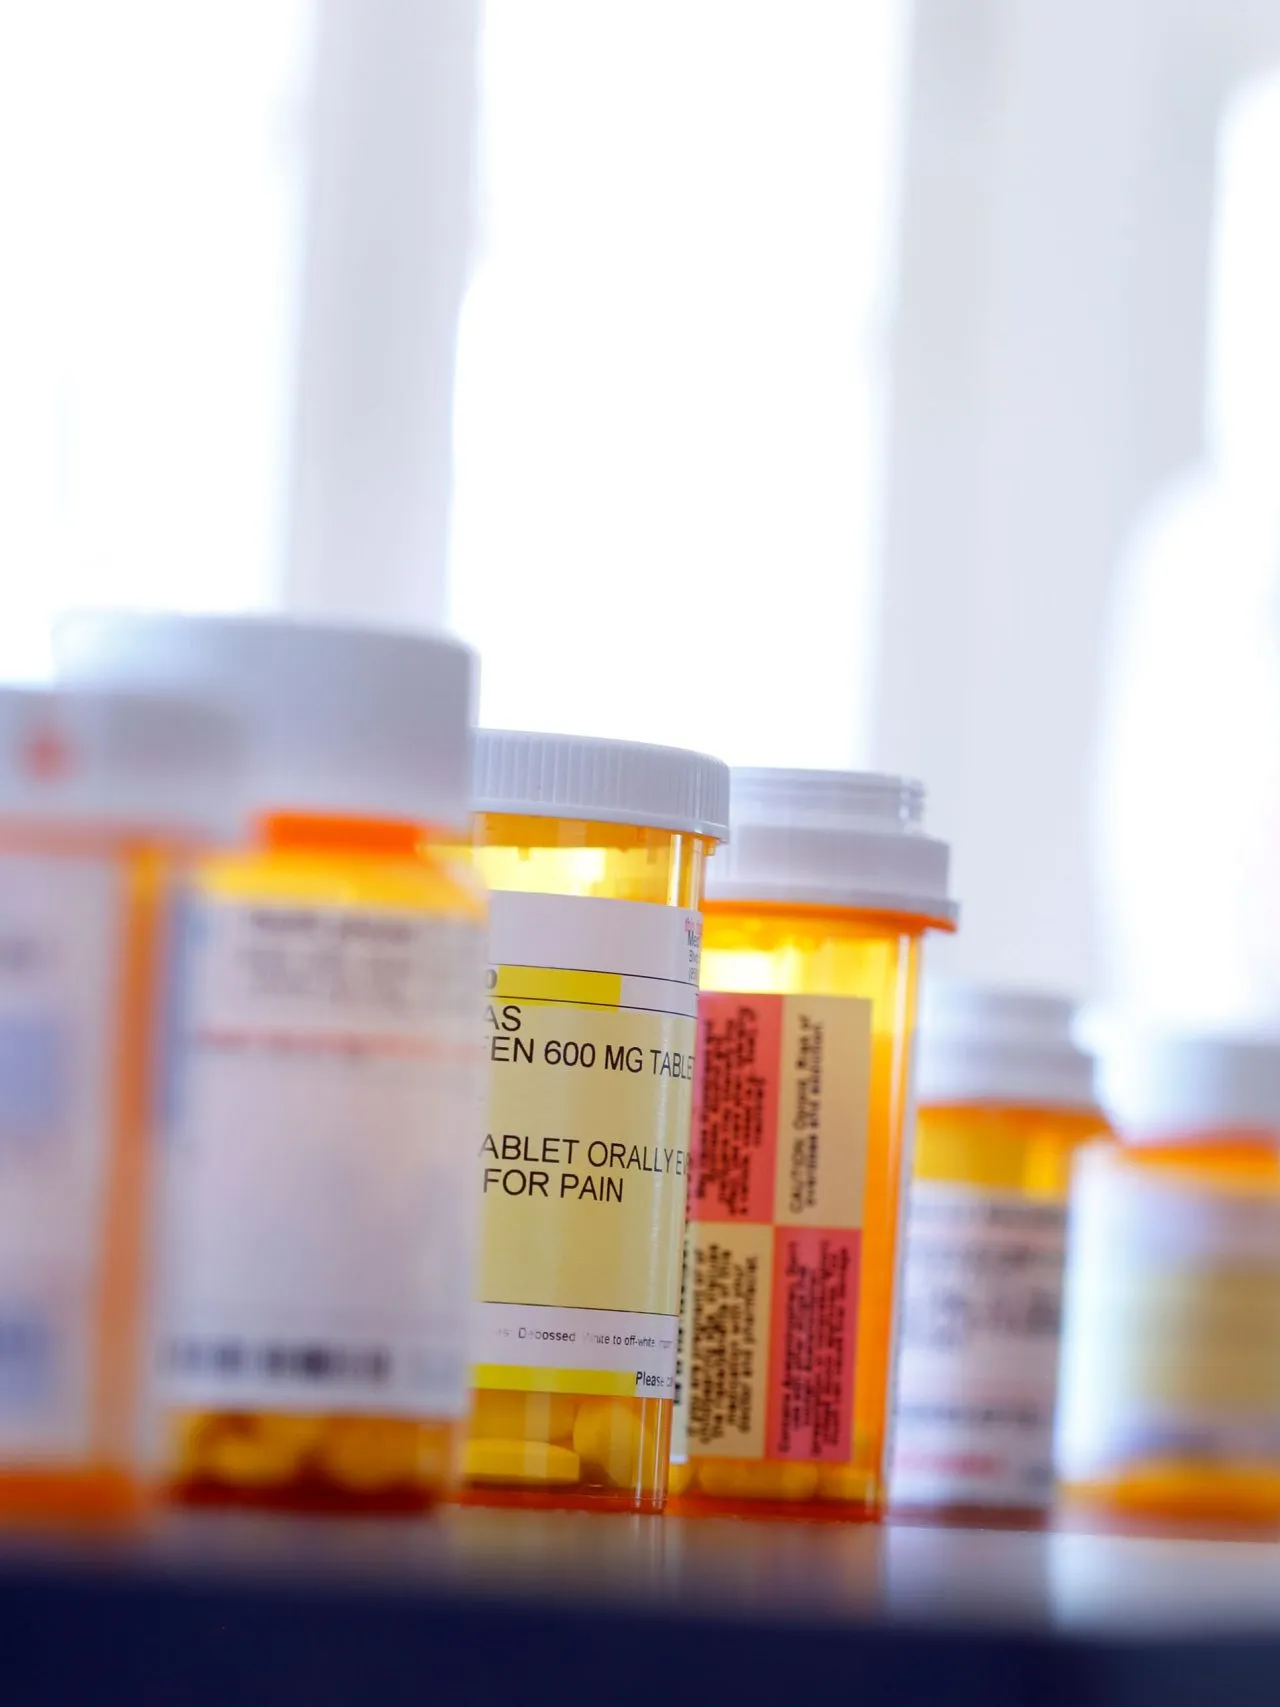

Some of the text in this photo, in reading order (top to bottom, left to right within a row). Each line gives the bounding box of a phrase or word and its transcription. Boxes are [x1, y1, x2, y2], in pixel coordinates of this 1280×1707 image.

[485, 1035, 535, 1064] EN
[544, 1039, 596, 1068] 600
[604, 1045, 644, 1074] MG
[649, 1049, 695, 1081] TABLE
[587, 1140, 674, 1175] ORALLY
[483, 1168, 624, 1204] FOR PAIN
[612, 1334, 622, 1346] to
